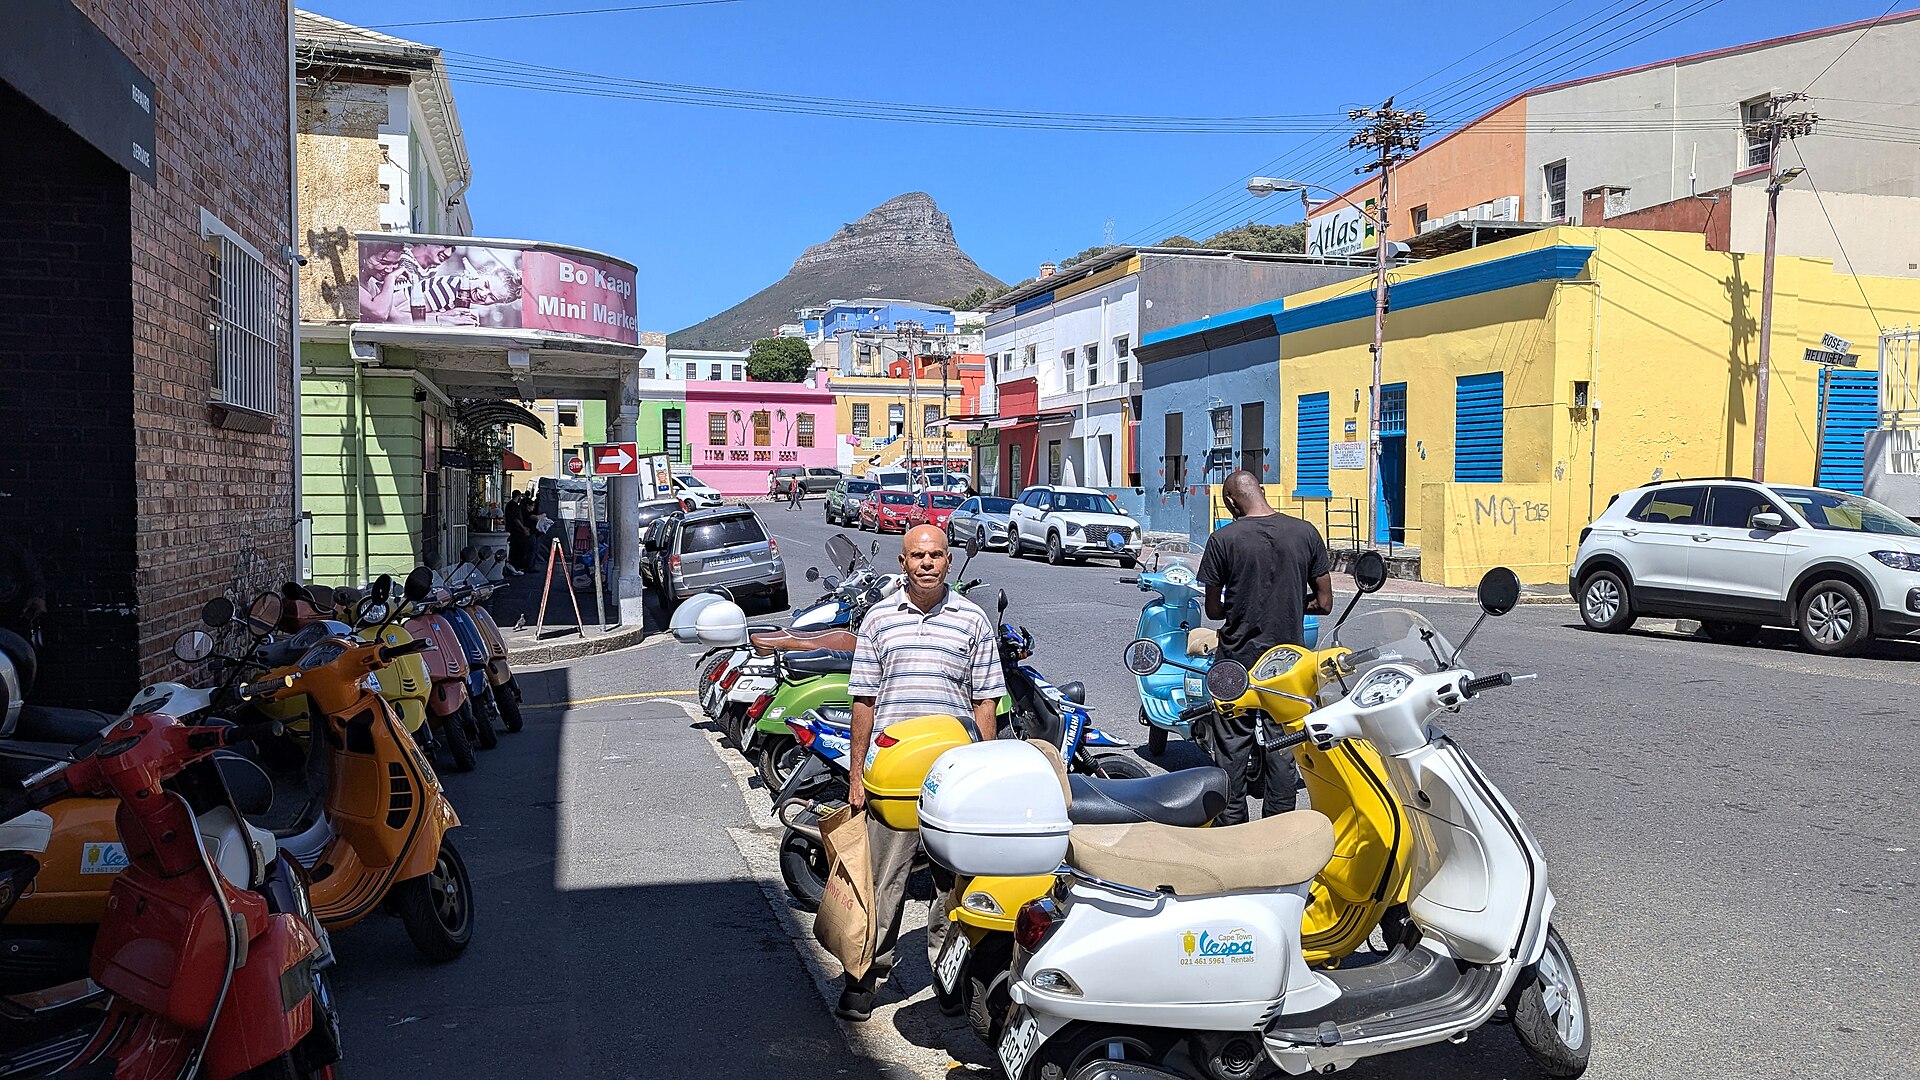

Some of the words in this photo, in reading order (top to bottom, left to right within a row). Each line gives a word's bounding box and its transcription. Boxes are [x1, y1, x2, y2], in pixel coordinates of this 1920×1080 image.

[132, 141, 150, 168] SERVICE
[1309, 213, 1359, 255] Atlas
[559, 262, 588, 284] Bo
[595, 268, 631, 299] Kaap
[537, 295, 586, 320] Mini
[1822, 333, 1842, 350] ROSE
[1804, 349, 1843, 365] HELLIGER
[570, 461, 582, 470] STOP
[1066, 715, 1079, 747] YAMAHA
[1199, 930, 1254, 957] Vespa
[1217, 934, 1235, 942] Cape
[1180, 958, 1192, 966] 021
[1208, 957, 1225, 965] 5961
[1022, 1021, 1035, 1050] 5
